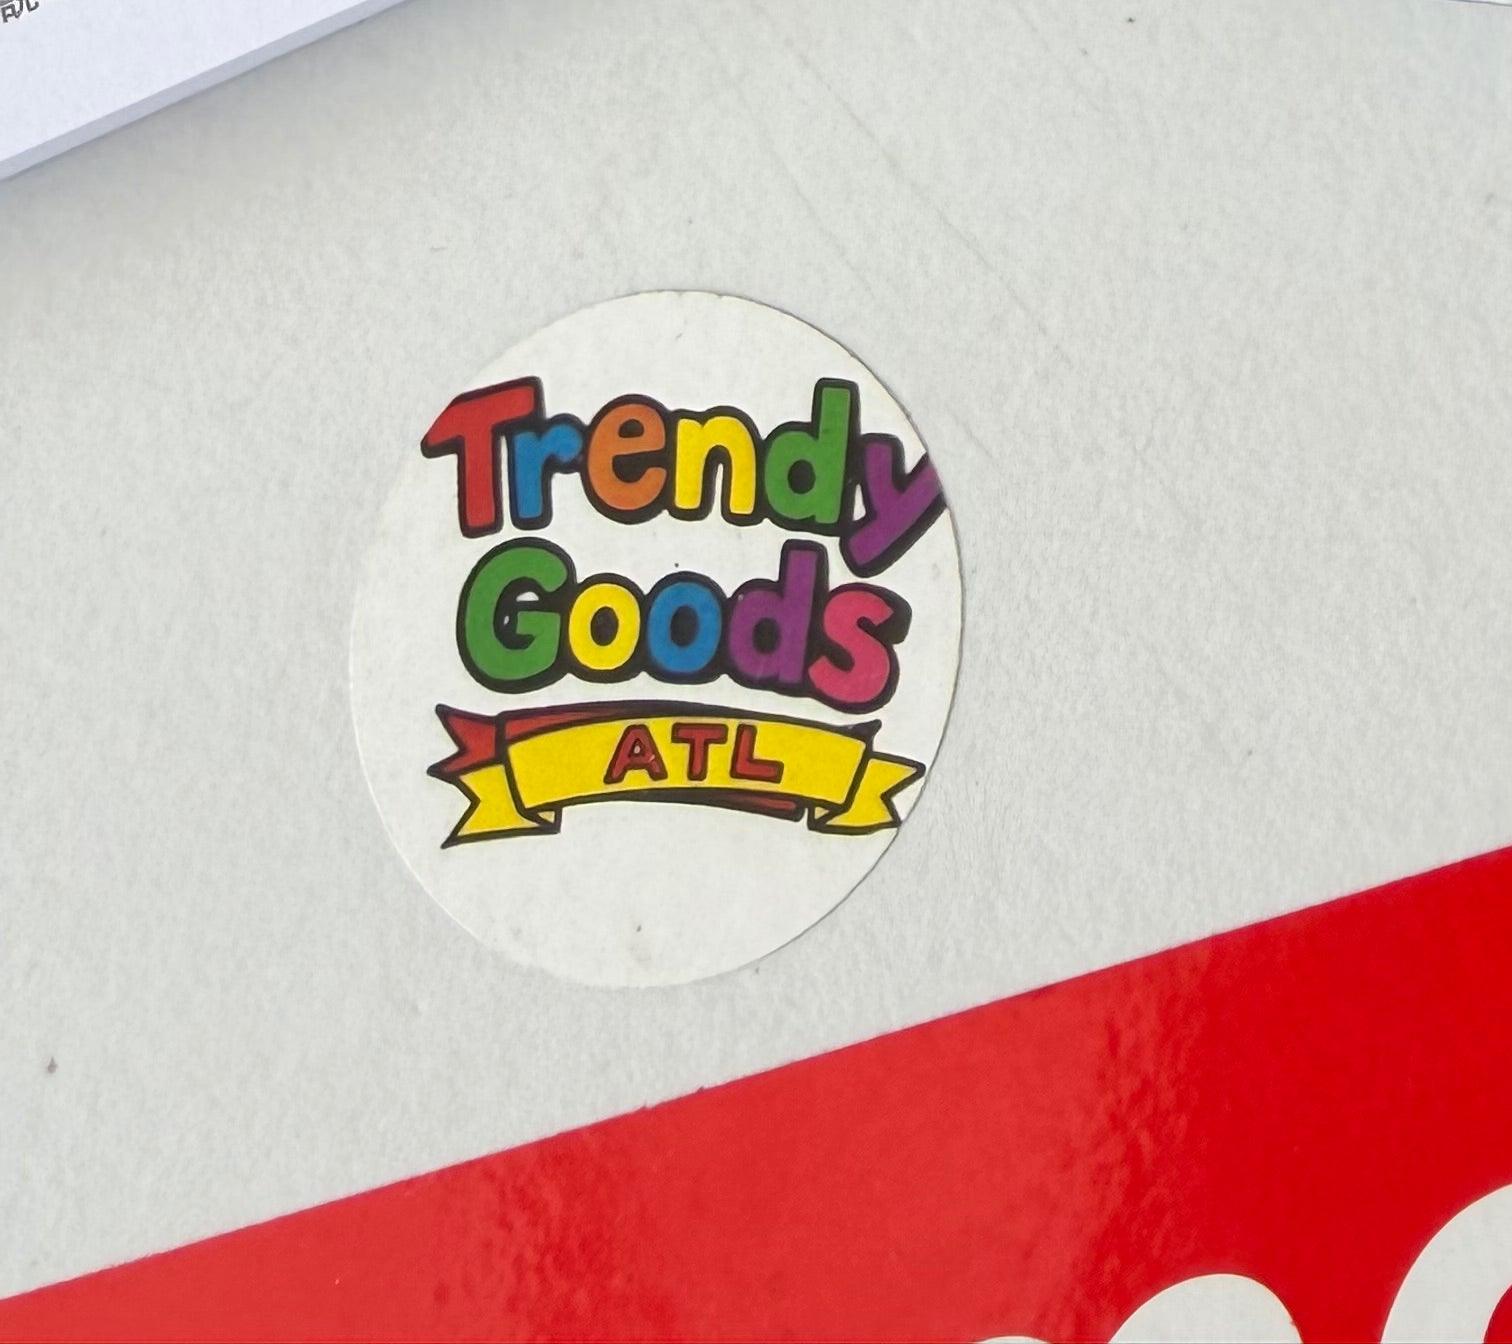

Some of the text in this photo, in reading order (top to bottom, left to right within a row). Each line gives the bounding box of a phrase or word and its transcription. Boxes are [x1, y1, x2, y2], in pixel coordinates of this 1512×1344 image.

[420, 375, 951, 578] Trendy
[455, 536, 913, 714] Goods
[602, 722, 785, 786] ATL
